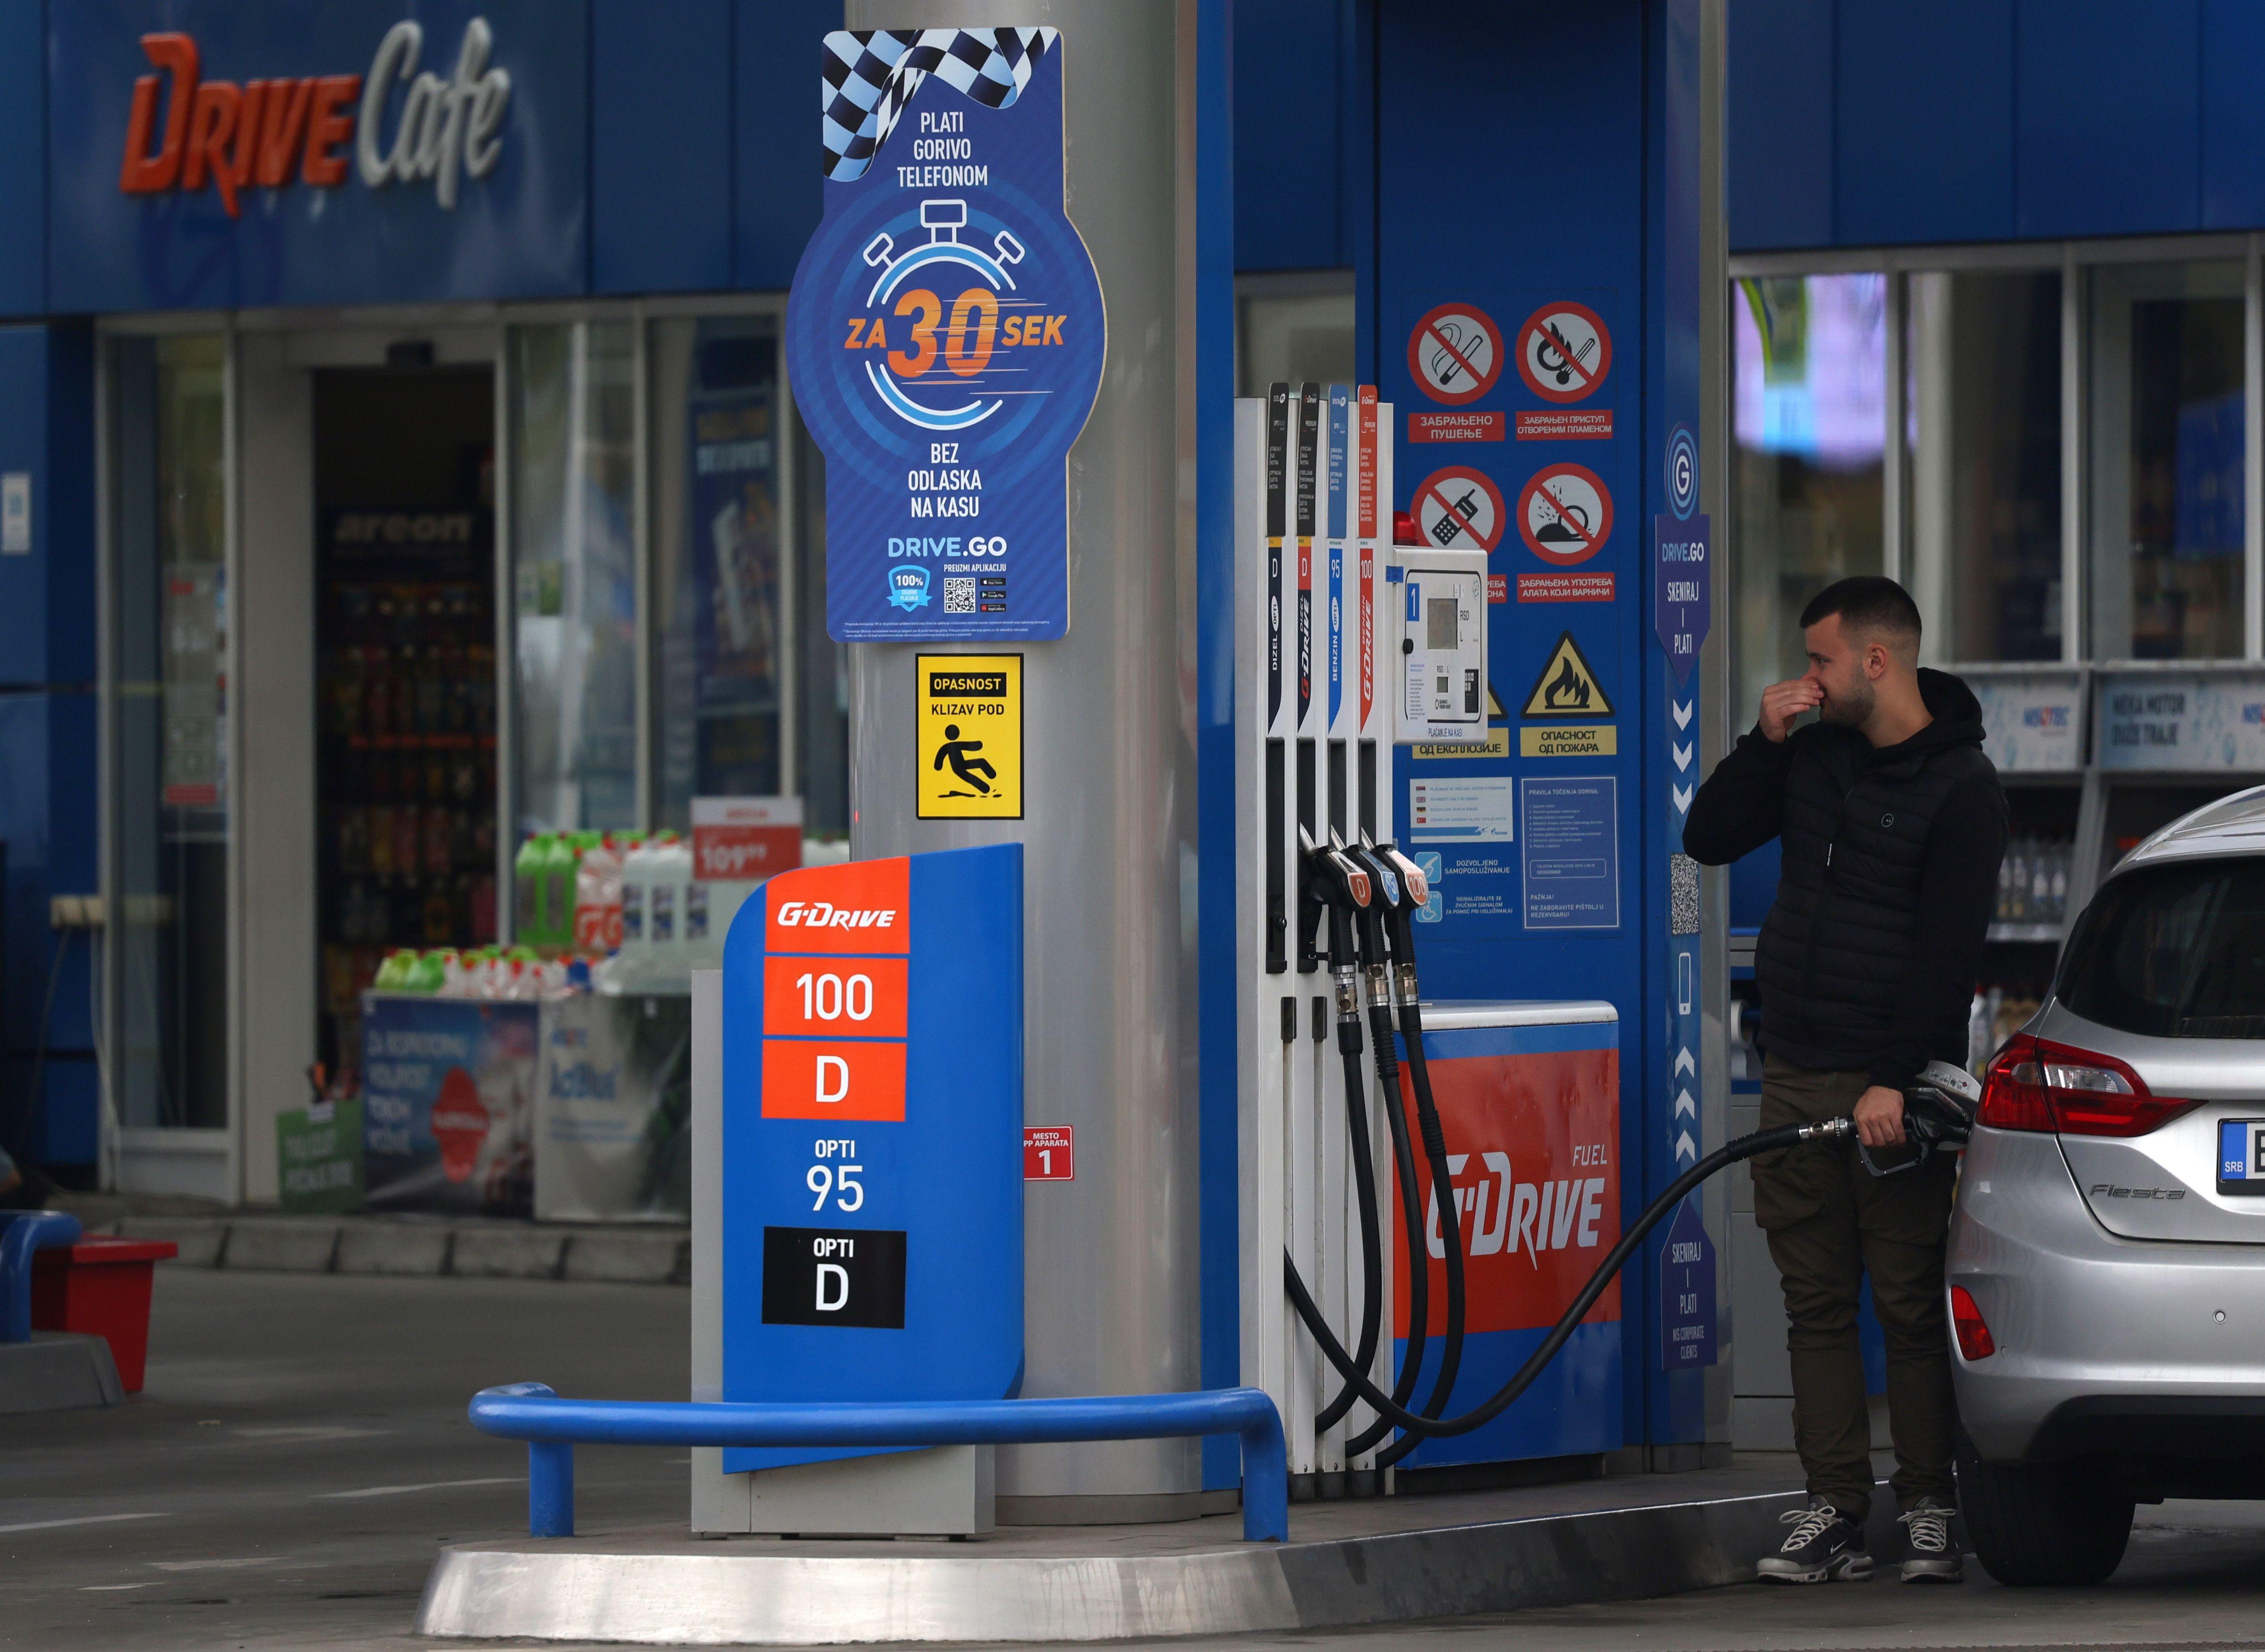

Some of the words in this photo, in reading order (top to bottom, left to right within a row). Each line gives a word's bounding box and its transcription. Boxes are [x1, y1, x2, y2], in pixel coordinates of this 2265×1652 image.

[119, 31, 362, 220] DRIVE
[357, 15, 511, 210] Cafe
[921, 112, 963, 133] PLATI
[914, 139, 971, 160] GORIVO
[897, 166, 988, 187] TELEFONOM
[844, 318, 887, 348] ZA
[887, 288, 999, 378] 30
[1001, 315, 1067, 346] SEK
[1421, 416, 1493, 426] ЗАБРАЊЕНО
[1517, 425, 1566, 434] ОТВОРЕНИМ
[1567, 425, 1612, 433] ПЛАМЕНОМ
[1525, 416, 1567, 425] ЗАБРАЊЕН
[1570, 416, 1604, 424] ПРИСТУП
[1431, 429, 1483, 439] ПУШЕЊЕ
[931, 443, 958, 463] BEZ
[908, 470, 982, 490] ODLASKA
[911, 497, 933, 517] NA
[937, 496, 979, 517] KASU
[888, 536, 1007, 557] DRIVE.GO
[1662, 542, 1704, 562] DRIVE.GO
[944, 564, 970, 572] PREUZMI
[971, 563, 1007, 572] APLIKACIJU
[1272, 558, 1277, 577] D
[1302, 558, 1307, 577] D
[1332, 559, 1340, 578] 95
[1361, 560, 1372, 579] 100
[896, 575, 923, 586] 100%
[1520, 578, 1569, 587] ЗАБРАЊЕНА
[1571, 578, 1612, 587] УПОТРЕБА
[1522, 588, 1548, 597] АЛАТА
[1550, 588, 1571, 597] КОЈИ
[1572, 588, 1609, 597] ВАРНИЧИ
[1667, 582, 1698, 602] SKENIRAJ
[1411, 588, 1416, 617] 1
[1460, 610, 1469, 621] RSD
[1682, 608, 1684, 628] I
[1674, 634, 1692, 654] PLATI
[934, 678, 1001, 690] OPASNOST
[932, 704, 974, 715] KLIZAV
[978, 704, 1005, 715] POD
[1428, 726, 1447, 737] PLAĆANJE
[1448, 728, 1453, 737] NA
[1454, 728, 1463, 737] KASI
[1541, 731, 1596, 740] ОПАСНОСТ
[1420, 745, 1434, 755] ОД
[1437, 744, 1501, 754] ЕКСПЛОЗИЈЕ
[1539, 744, 1554, 754] ОД
[1556, 743, 1599, 753] ПОЖАРА
[1358, 878, 1365, 899] D
[1410, 876, 1426, 896] 100
[777, 902, 896, 931] G-DRIVE
[796, 973, 873, 1021] 100
[815, 1055, 849, 1103] D
[815, 1139, 855, 1158] OPTI
[1573, 1144, 1607, 1166] FUEL
[1038, 1149, 1051, 1174] 1
[2225, 1161, 2243, 1172] SRB
[806, 1165, 864, 1212] 95
[2089, 1184, 2186, 1200] Fiesta
[813, 1238, 854, 1257] OPTI
[1672, 1242, 1701, 1263] SKENIRAJ
[815, 1263, 849, 1311] D
[1687, 1268, 1689, 1288] I
[1680, 1294, 1697, 1314] PLATI
[1681, 1325, 1704, 1340] CORPORATE
[1681, 1345, 1697, 1359] CLIENTS
